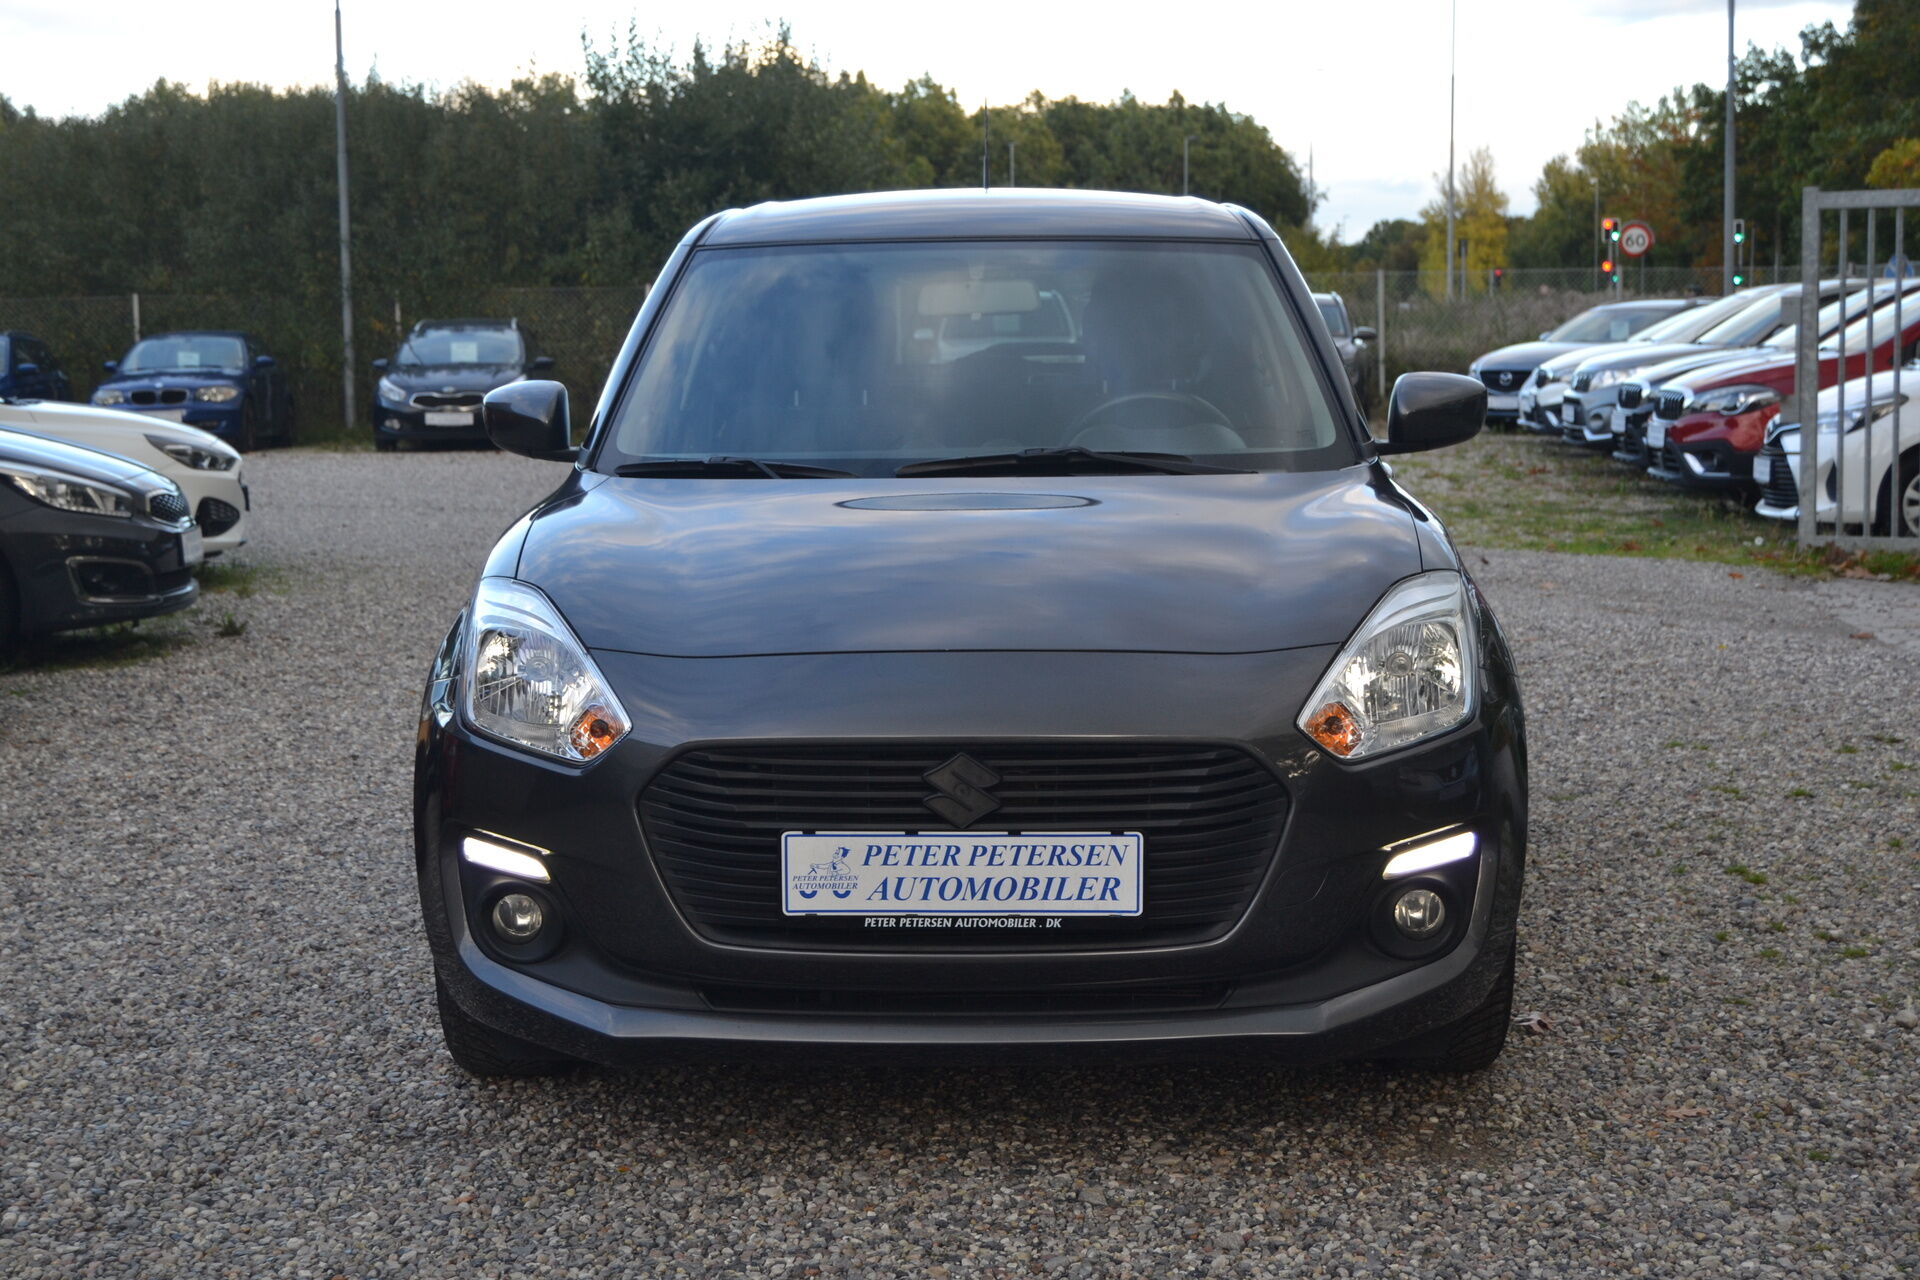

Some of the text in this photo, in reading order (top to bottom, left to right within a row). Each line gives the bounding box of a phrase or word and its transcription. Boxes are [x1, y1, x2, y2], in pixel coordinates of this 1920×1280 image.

[1625, 234, 1646, 248] 60
[861, 844, 1130, 867] PETER PETERSEN
[792, 882, 859, 890] AUTOMOBILER
[866, 876, 1121, 901] AUTOMOBILER
[864, 917, 896, 928] PETER
[899, 917, 951, 928] PETERSEN
[955, 917, 1037, 928] AUTOMOBILER
